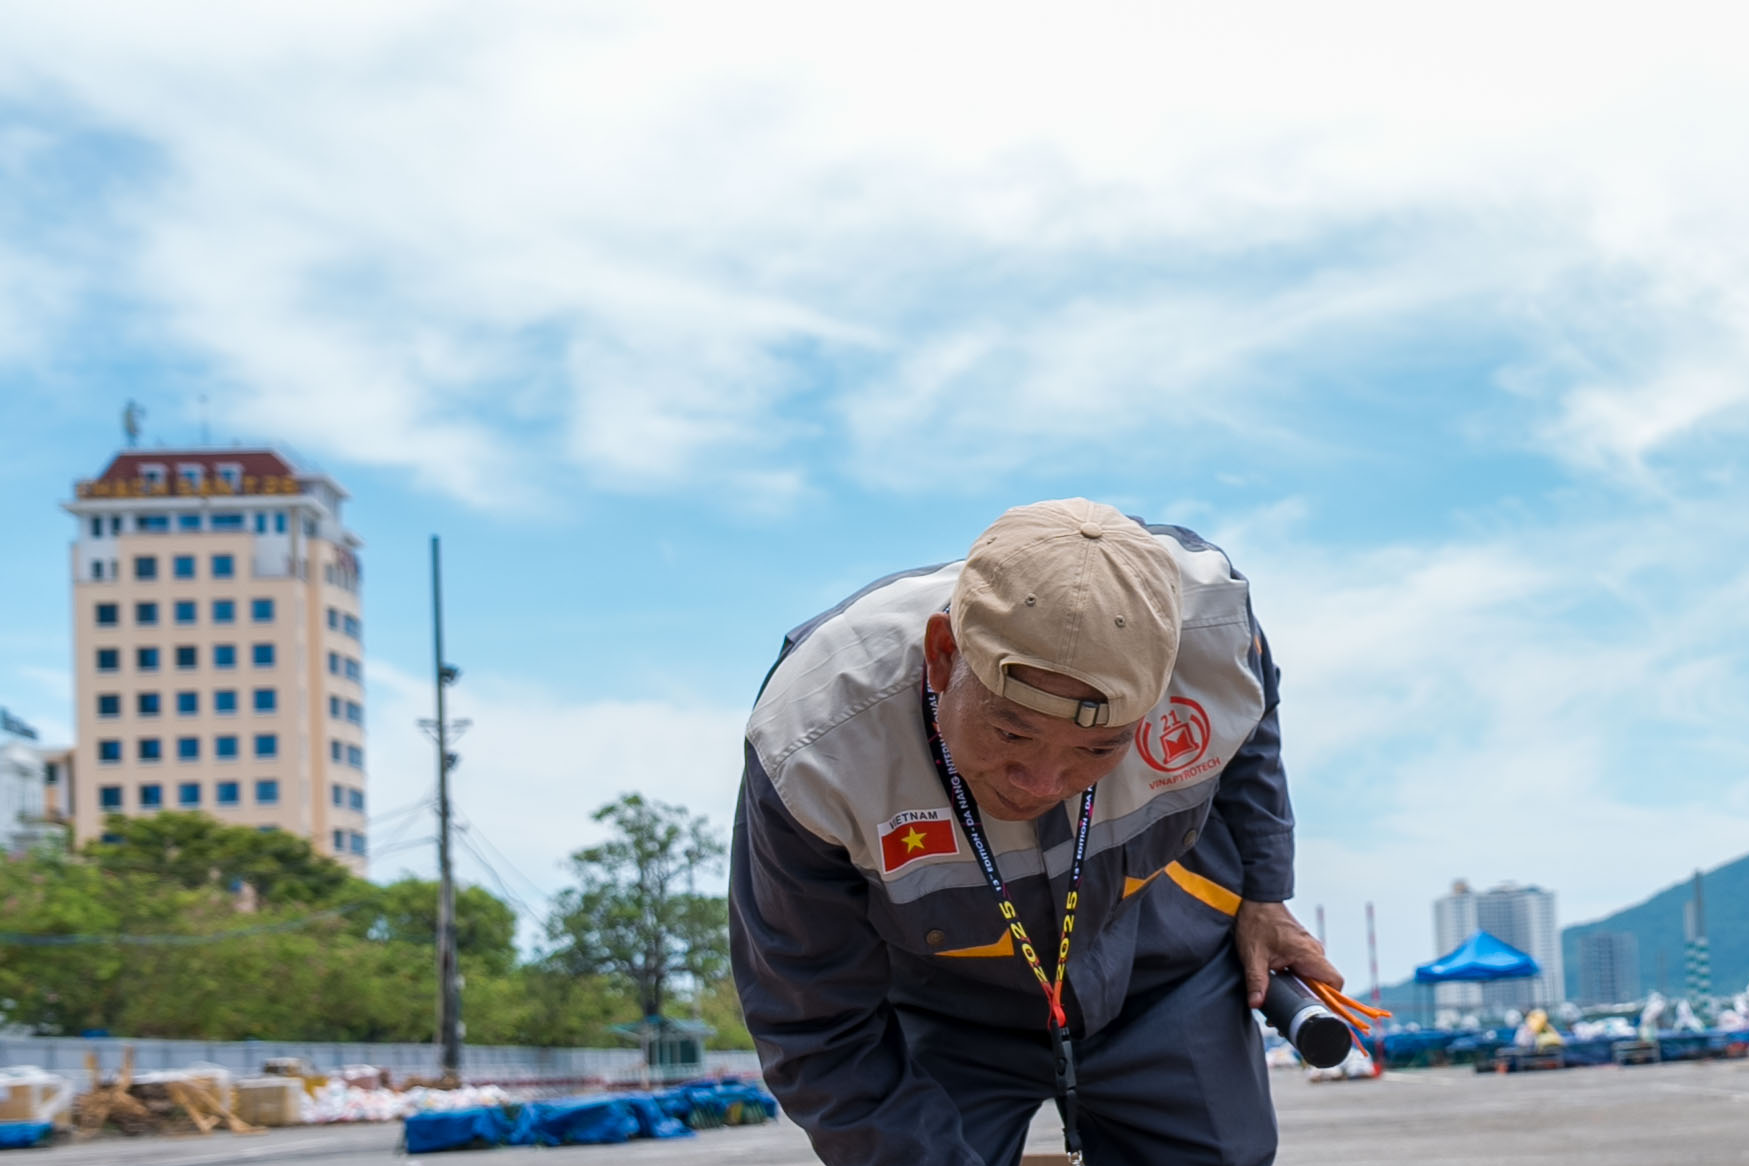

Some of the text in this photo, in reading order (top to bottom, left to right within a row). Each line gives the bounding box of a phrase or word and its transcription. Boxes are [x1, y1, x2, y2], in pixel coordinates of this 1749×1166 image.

[951, 775, 969, 810] NANG
[1149, 757, 1221, 790] VINAPYROTECH
[971, 832, 995, 874] EDITION
[1076, 817, 1088, 860] EDITION
[999, 901, 1048, 982] 2025
[1056, 890, 1078, 981] 2025
